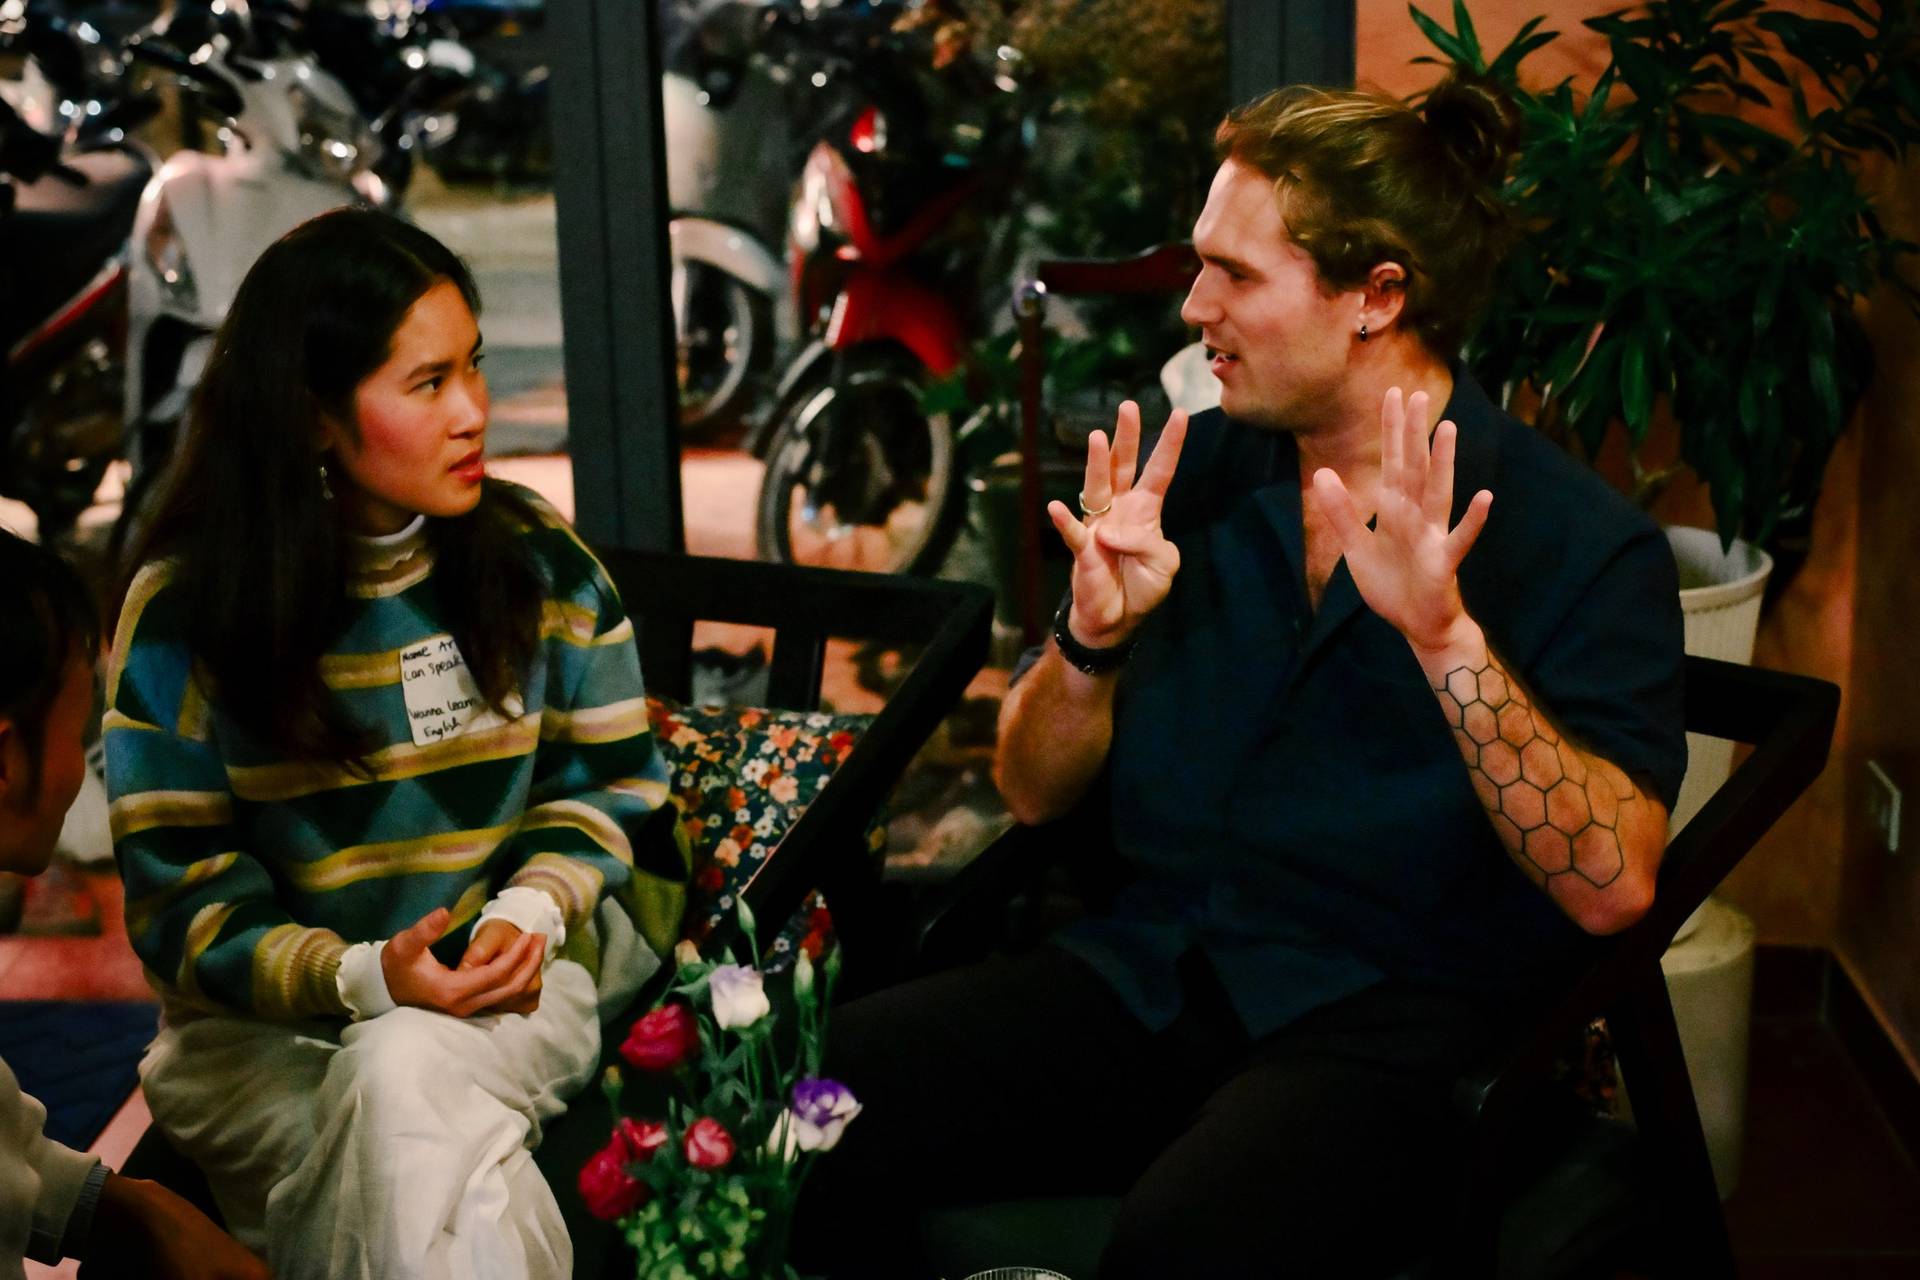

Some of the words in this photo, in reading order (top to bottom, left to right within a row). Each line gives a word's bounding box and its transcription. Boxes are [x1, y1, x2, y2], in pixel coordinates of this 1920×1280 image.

[402, 646, 432, 662] Name
[404, 668, 426, 682] Can
[423, 717, 462, 741] English
